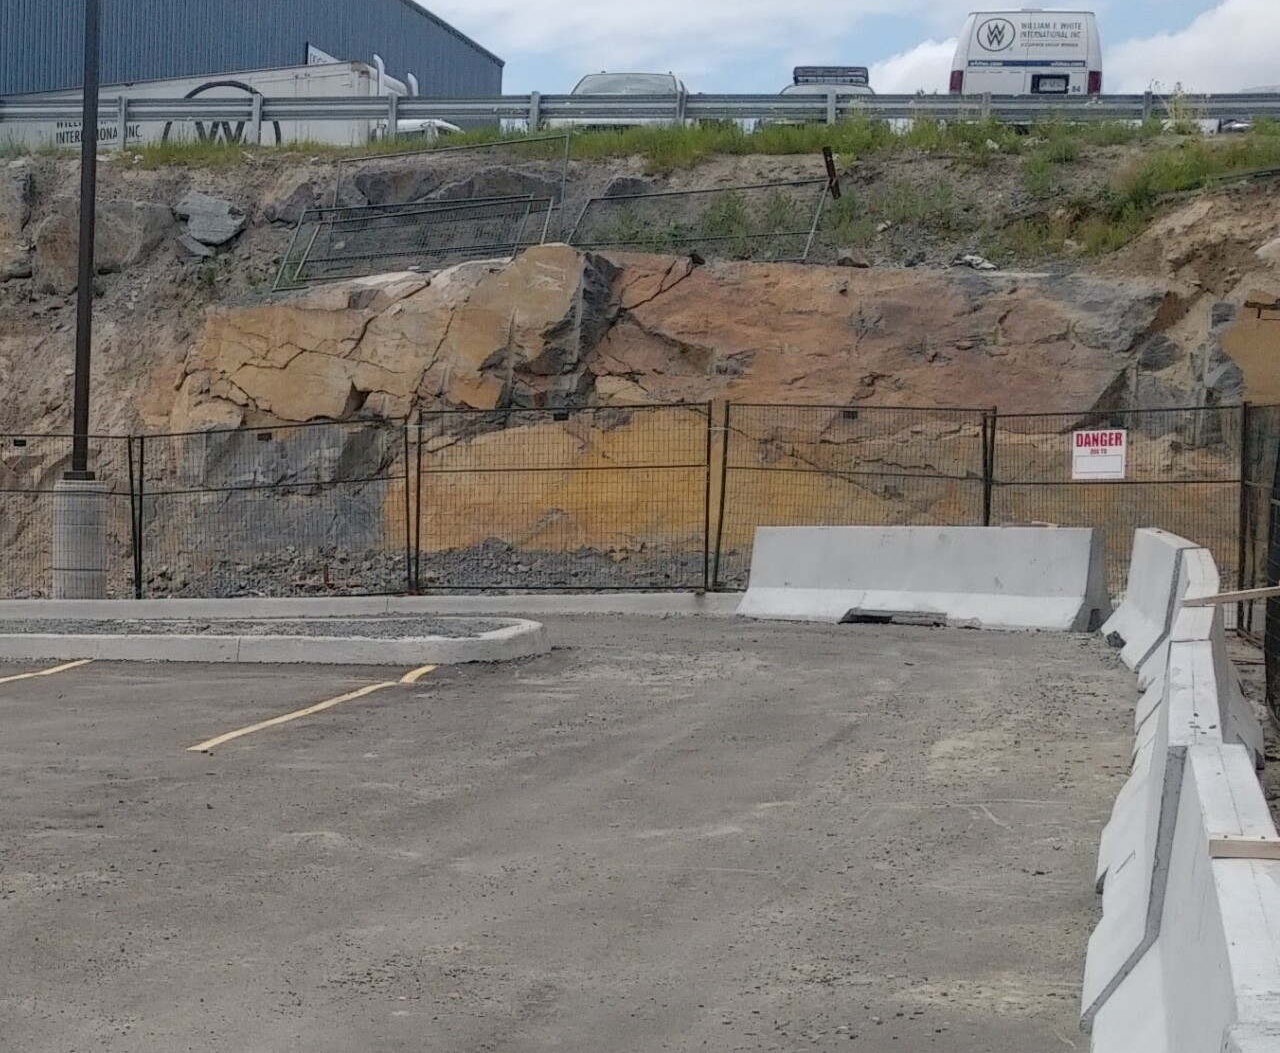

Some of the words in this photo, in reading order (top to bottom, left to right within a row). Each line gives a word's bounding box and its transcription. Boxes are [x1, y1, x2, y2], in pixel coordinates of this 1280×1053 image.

[1021, 22, 1051, 30] WILLIAM
[1060, 22, 1081, 30] WHITE
[1076, 432, 1123, 447] DANGER
